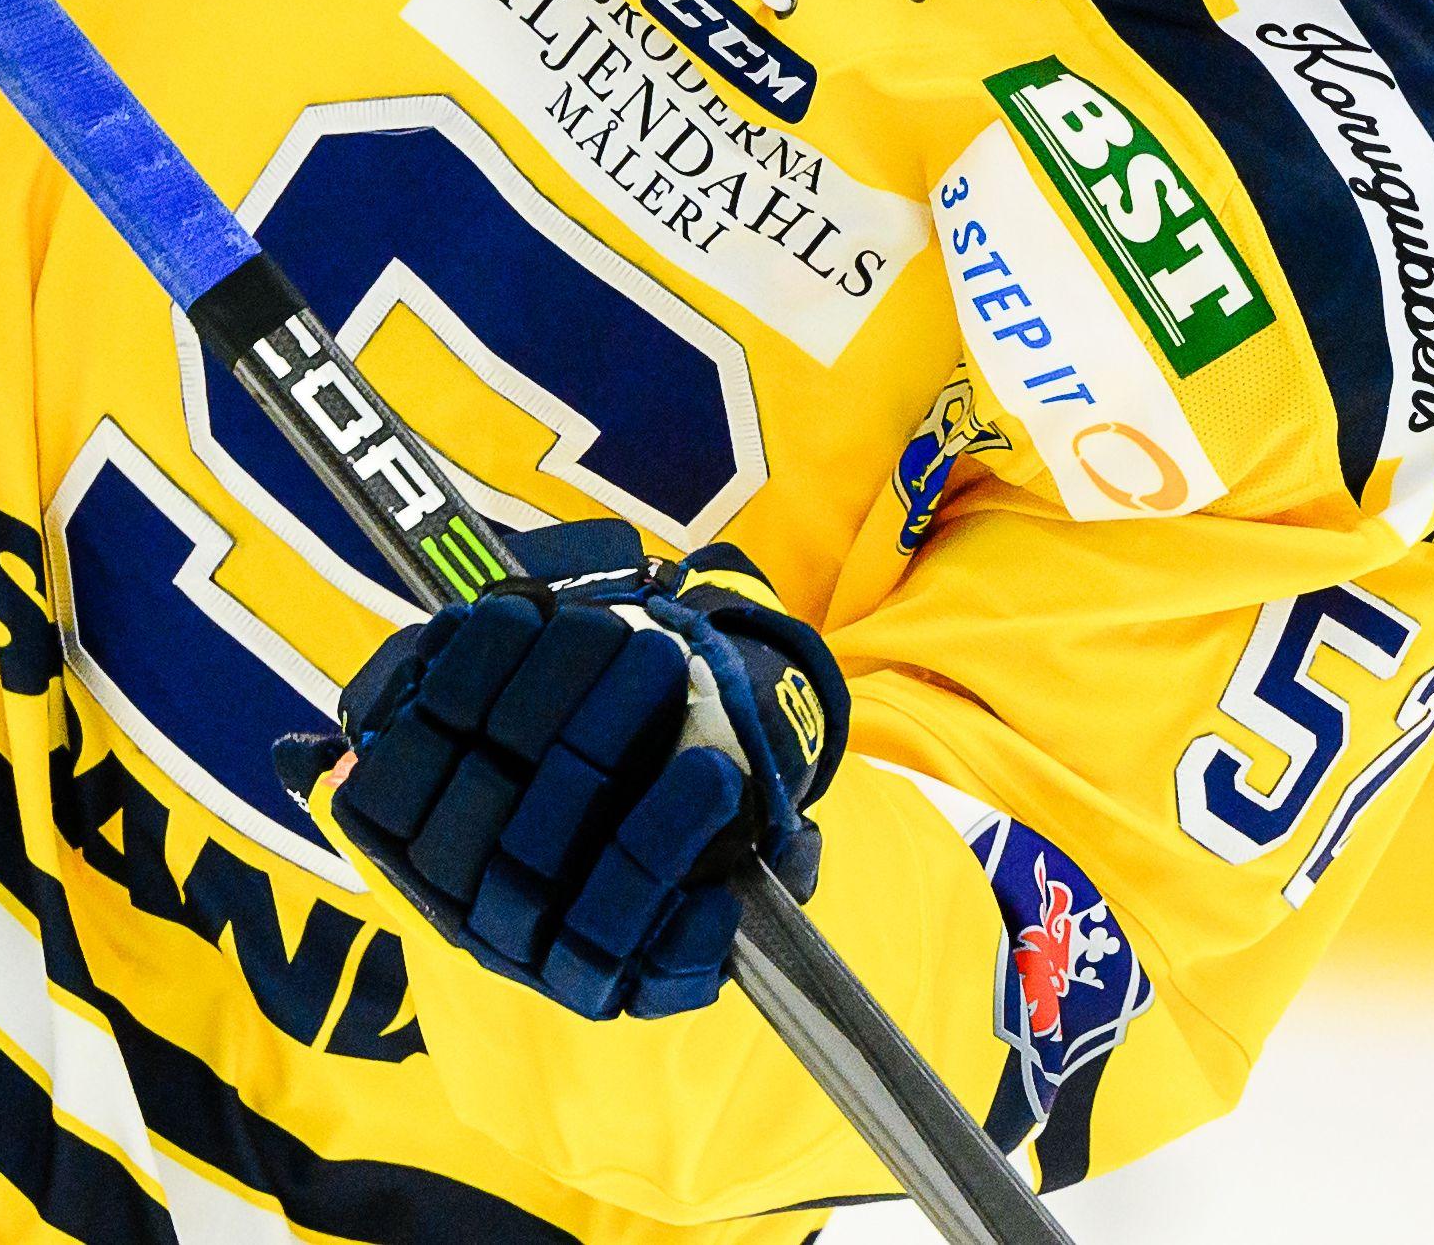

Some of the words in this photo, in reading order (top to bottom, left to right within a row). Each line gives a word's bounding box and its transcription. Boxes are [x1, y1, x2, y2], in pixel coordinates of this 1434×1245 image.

[545, 81, 732, 255] MÅLERI
[941, 176, 969, 211] 3
[1018, 73, 1255, 324] BST
[952, 220, 1053, 350] STEP
[1023, 365, 1097, 406] IT
